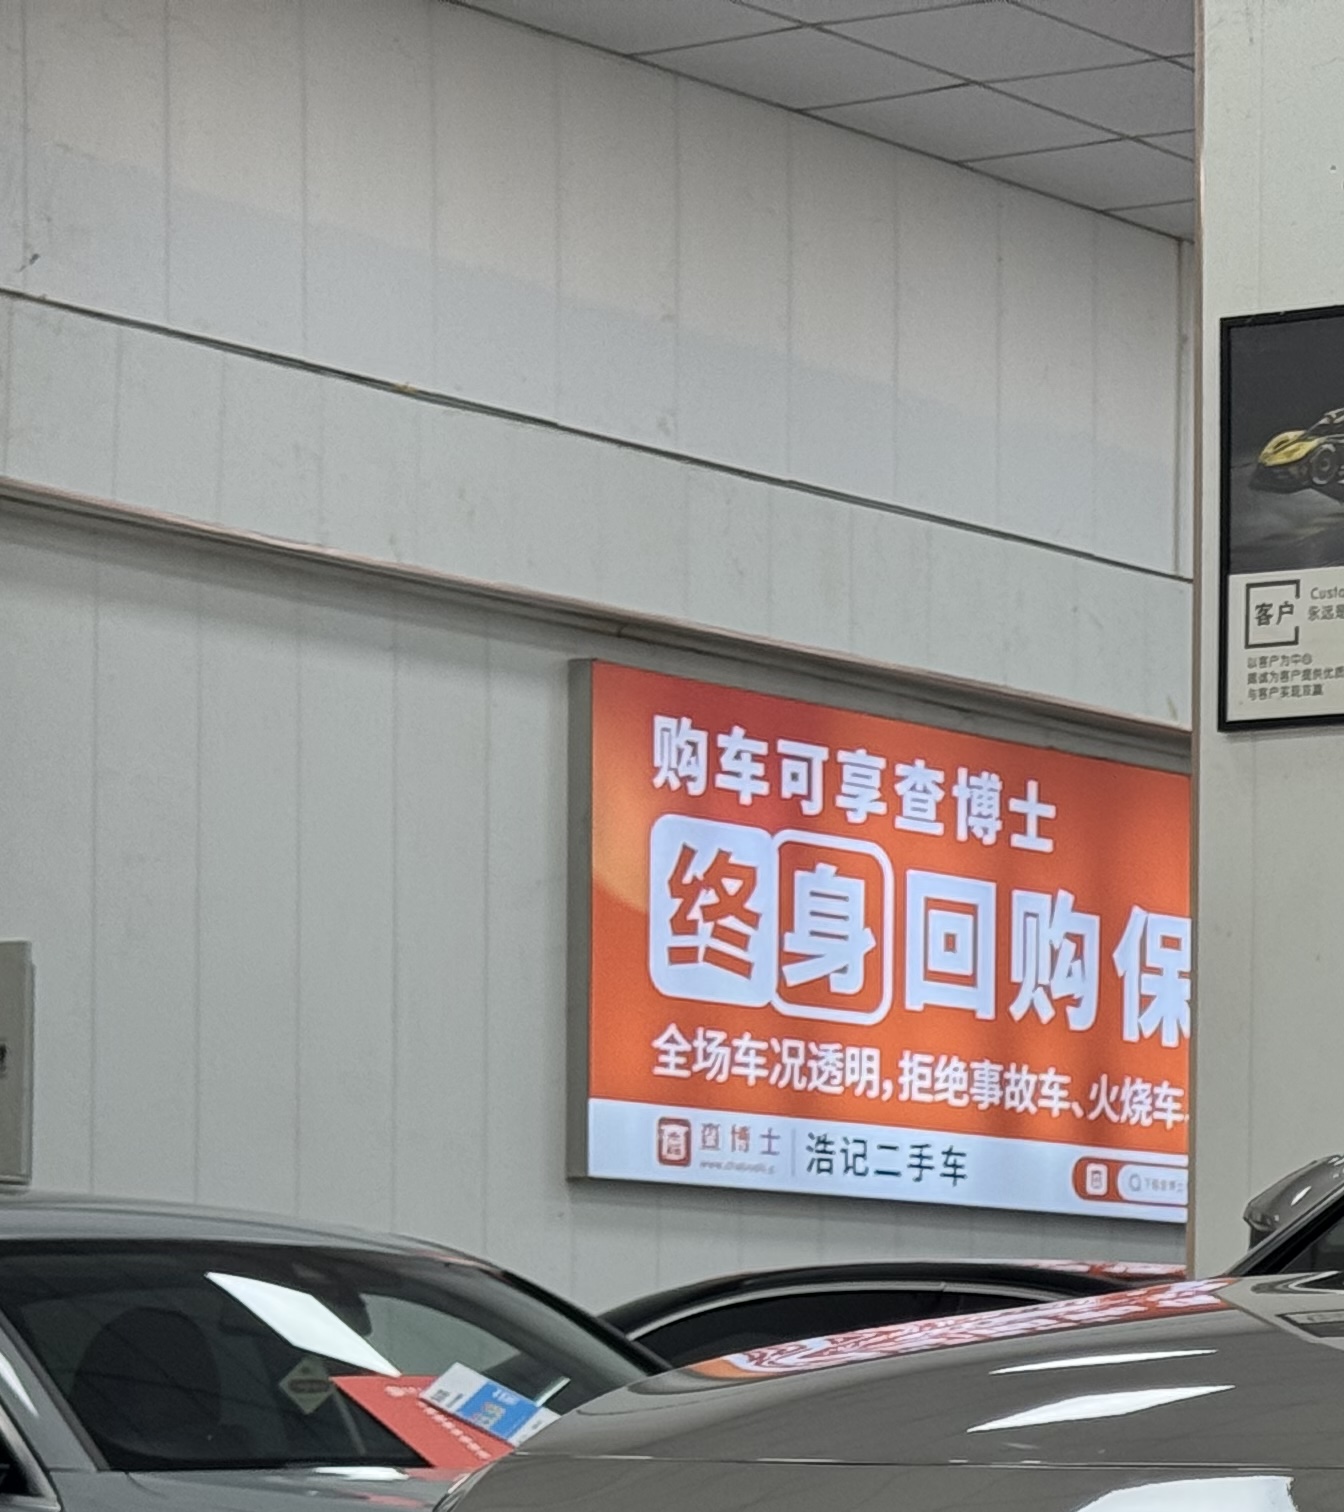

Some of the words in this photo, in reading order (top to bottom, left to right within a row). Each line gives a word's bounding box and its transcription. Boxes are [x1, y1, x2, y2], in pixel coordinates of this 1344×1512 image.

[1254, 600, 1295, 627] 客户
[652, 714, 1057, 853] 购车可享查博士
[664, 840, 1191, 1049] 终身回购保
[805, 1132, 968, 1186] 浩记二手车
